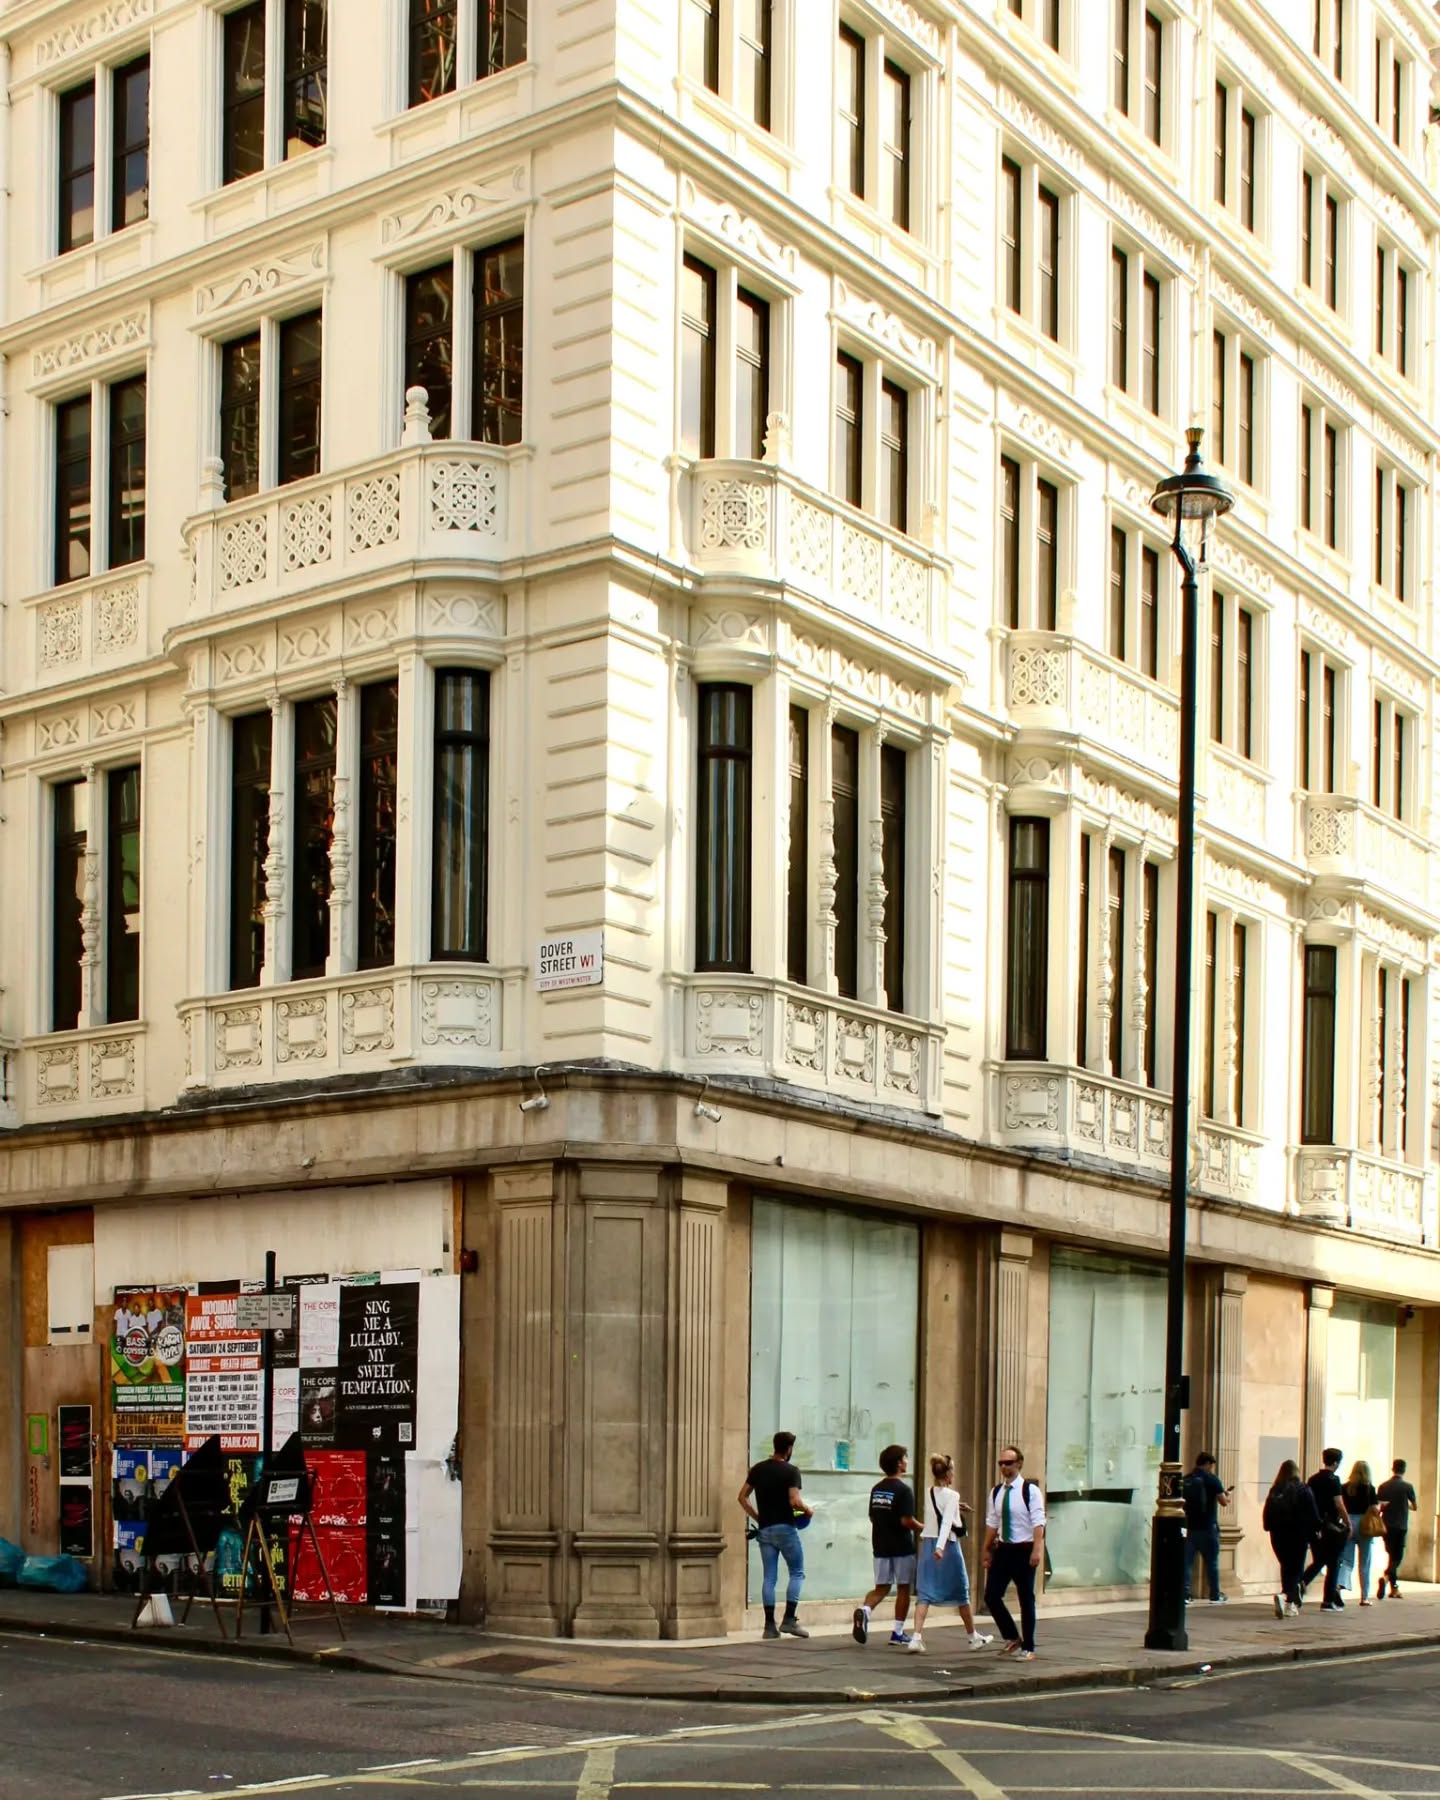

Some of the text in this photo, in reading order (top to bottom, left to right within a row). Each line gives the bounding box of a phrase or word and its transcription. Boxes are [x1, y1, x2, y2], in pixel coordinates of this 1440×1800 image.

[540, 941, 573, 958] DOVER
[540, 954, 595, 974] STREET W1
[558, 975, 592, 986] WESTMINSTER
[286, 1276, 326, 1285] PHONE
[303, 1302, 317, 1311] THE
[318, 1301, 337, 1310] COPE
[365, 1300, 391, 1315] SING
[363, 1316, 392, 1331] ME A
[190, 1329, 259, 1338] FESTIVAL
[126, 1337, 146, 1347] BASS
[189, 1341, 258, 1355] SATURDAY 24 SEPTEMBER
[123, 1347, 147, 1355] ODYSSEY
[368, 1348, 387, 1363] MY
[357, 1363, 397, 1379] SWEET
[302, 1377, 336, 1386] THE COPE
[340, 1379, 415, 1396] TEMPTATION.
[278, 1387, 296, 1396] COPE
